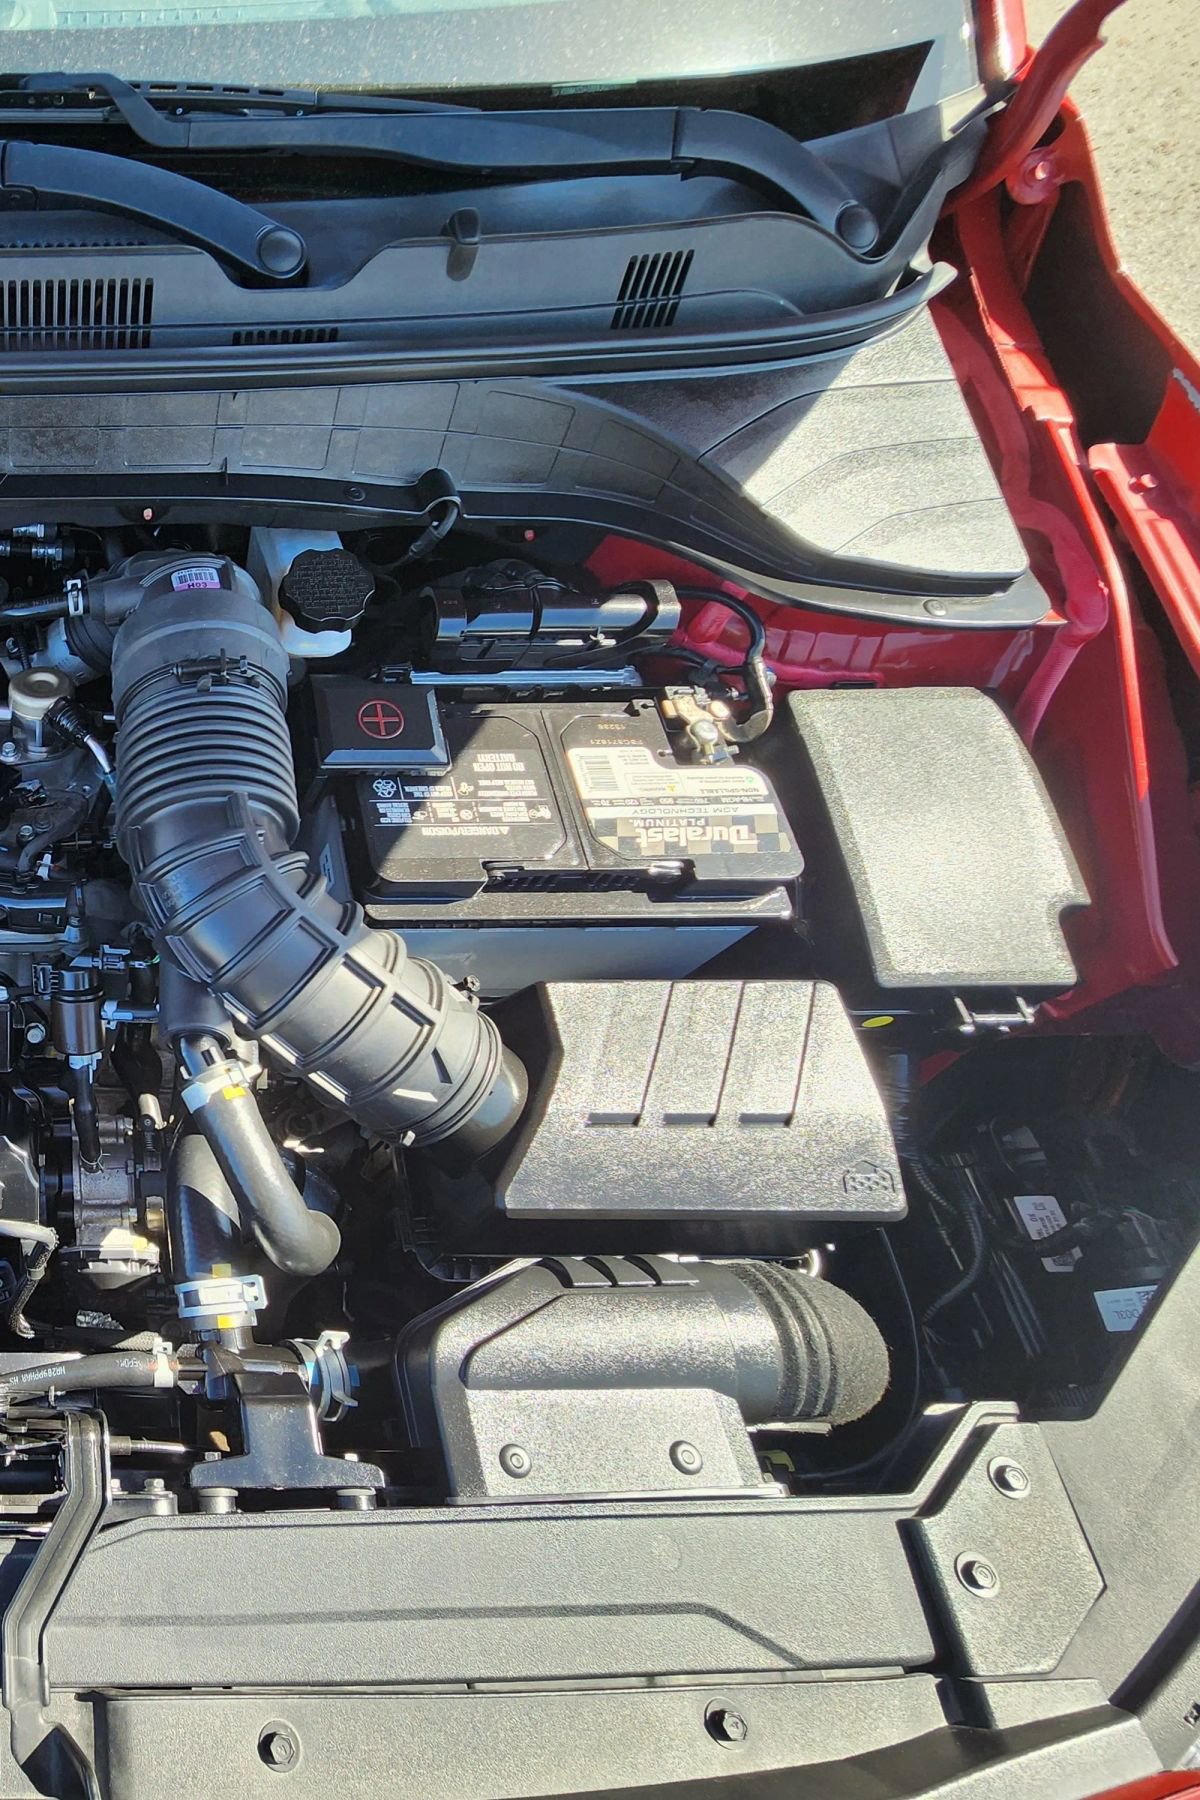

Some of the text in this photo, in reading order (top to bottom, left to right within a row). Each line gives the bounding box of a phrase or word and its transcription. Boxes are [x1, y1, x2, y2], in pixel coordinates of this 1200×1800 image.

[632, 806, 739, 815] AGM TECHNOLOGY
[635, 825, 760, 847] Duralast
